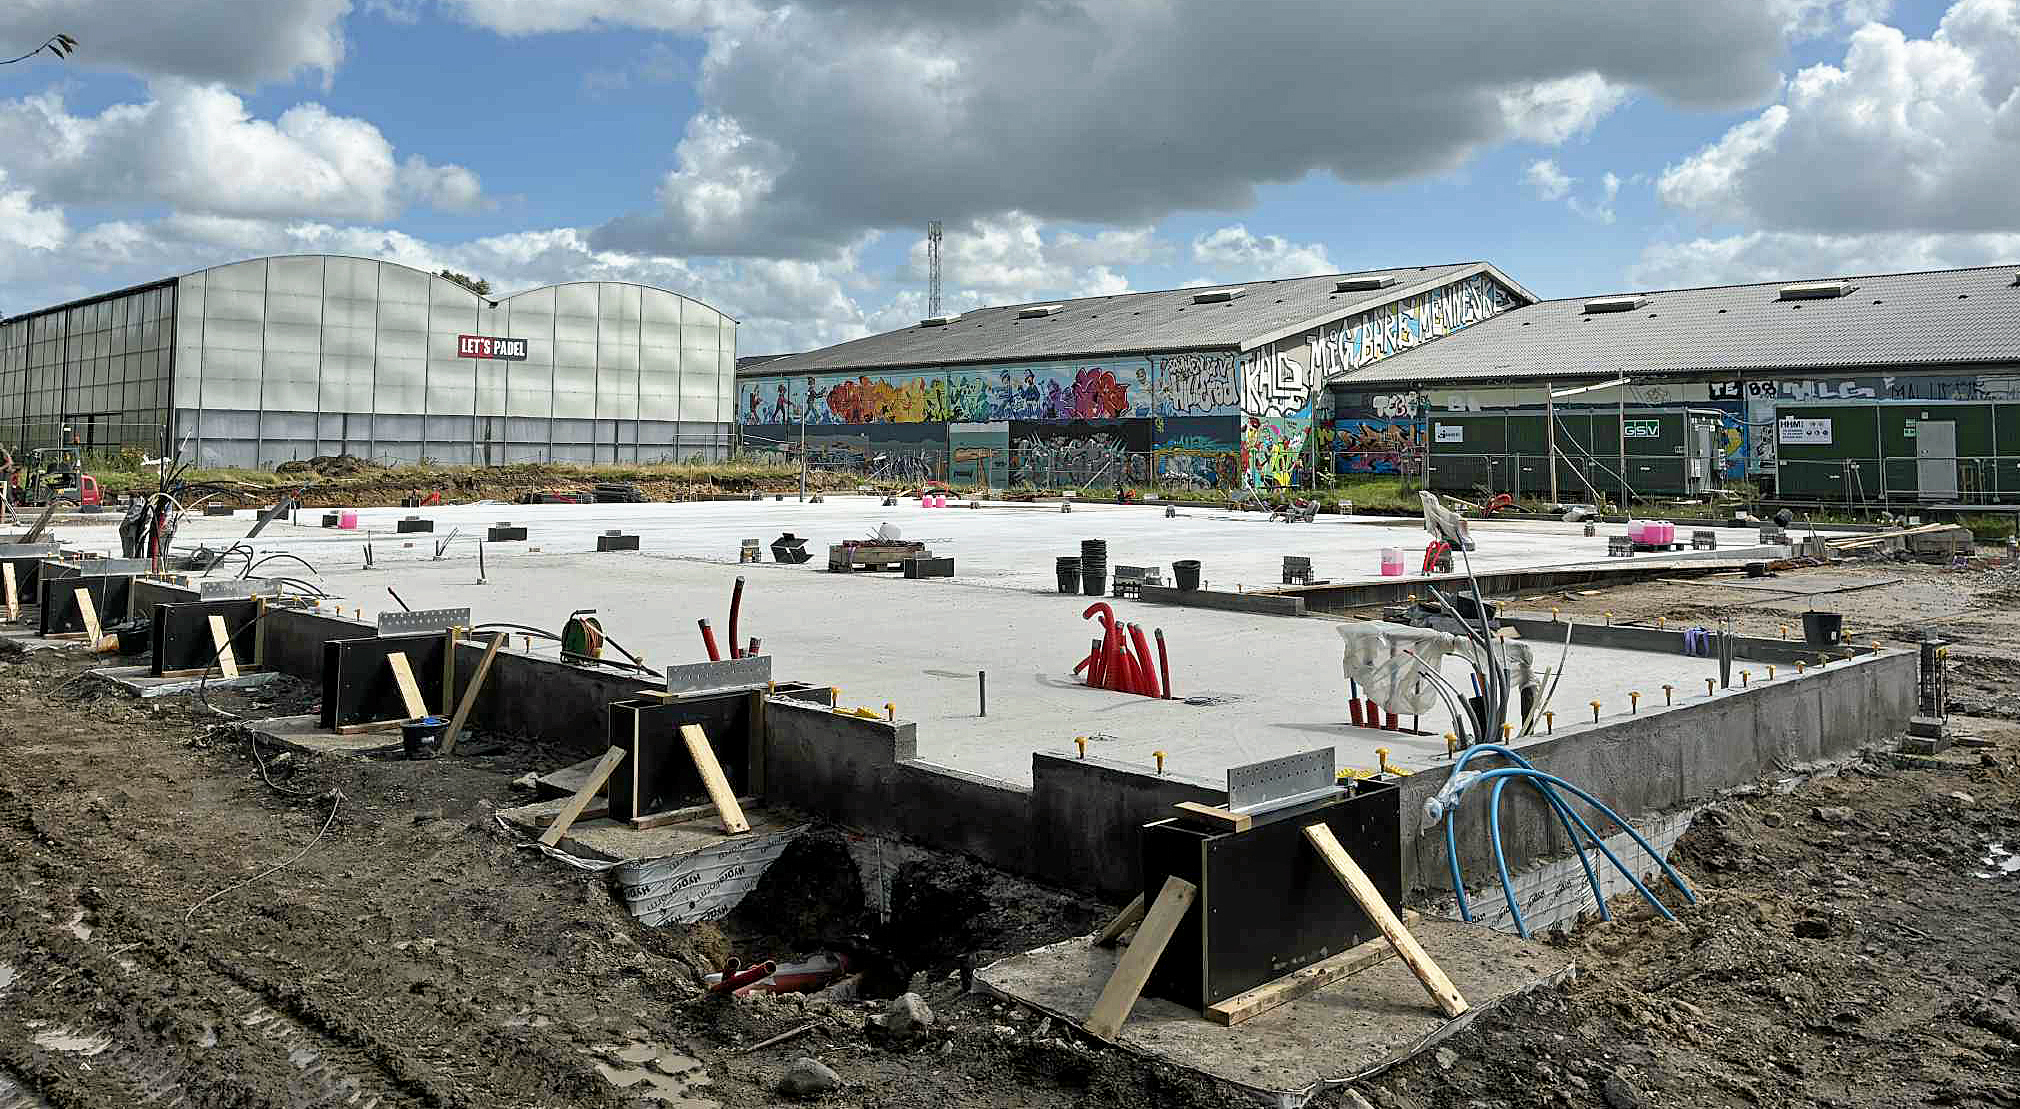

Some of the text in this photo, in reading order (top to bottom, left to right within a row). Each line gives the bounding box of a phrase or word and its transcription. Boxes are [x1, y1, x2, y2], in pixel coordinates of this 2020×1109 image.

[461, 338, 525, 357] LET'S PADEL
[1624, 426, 1658, 436] GSV
